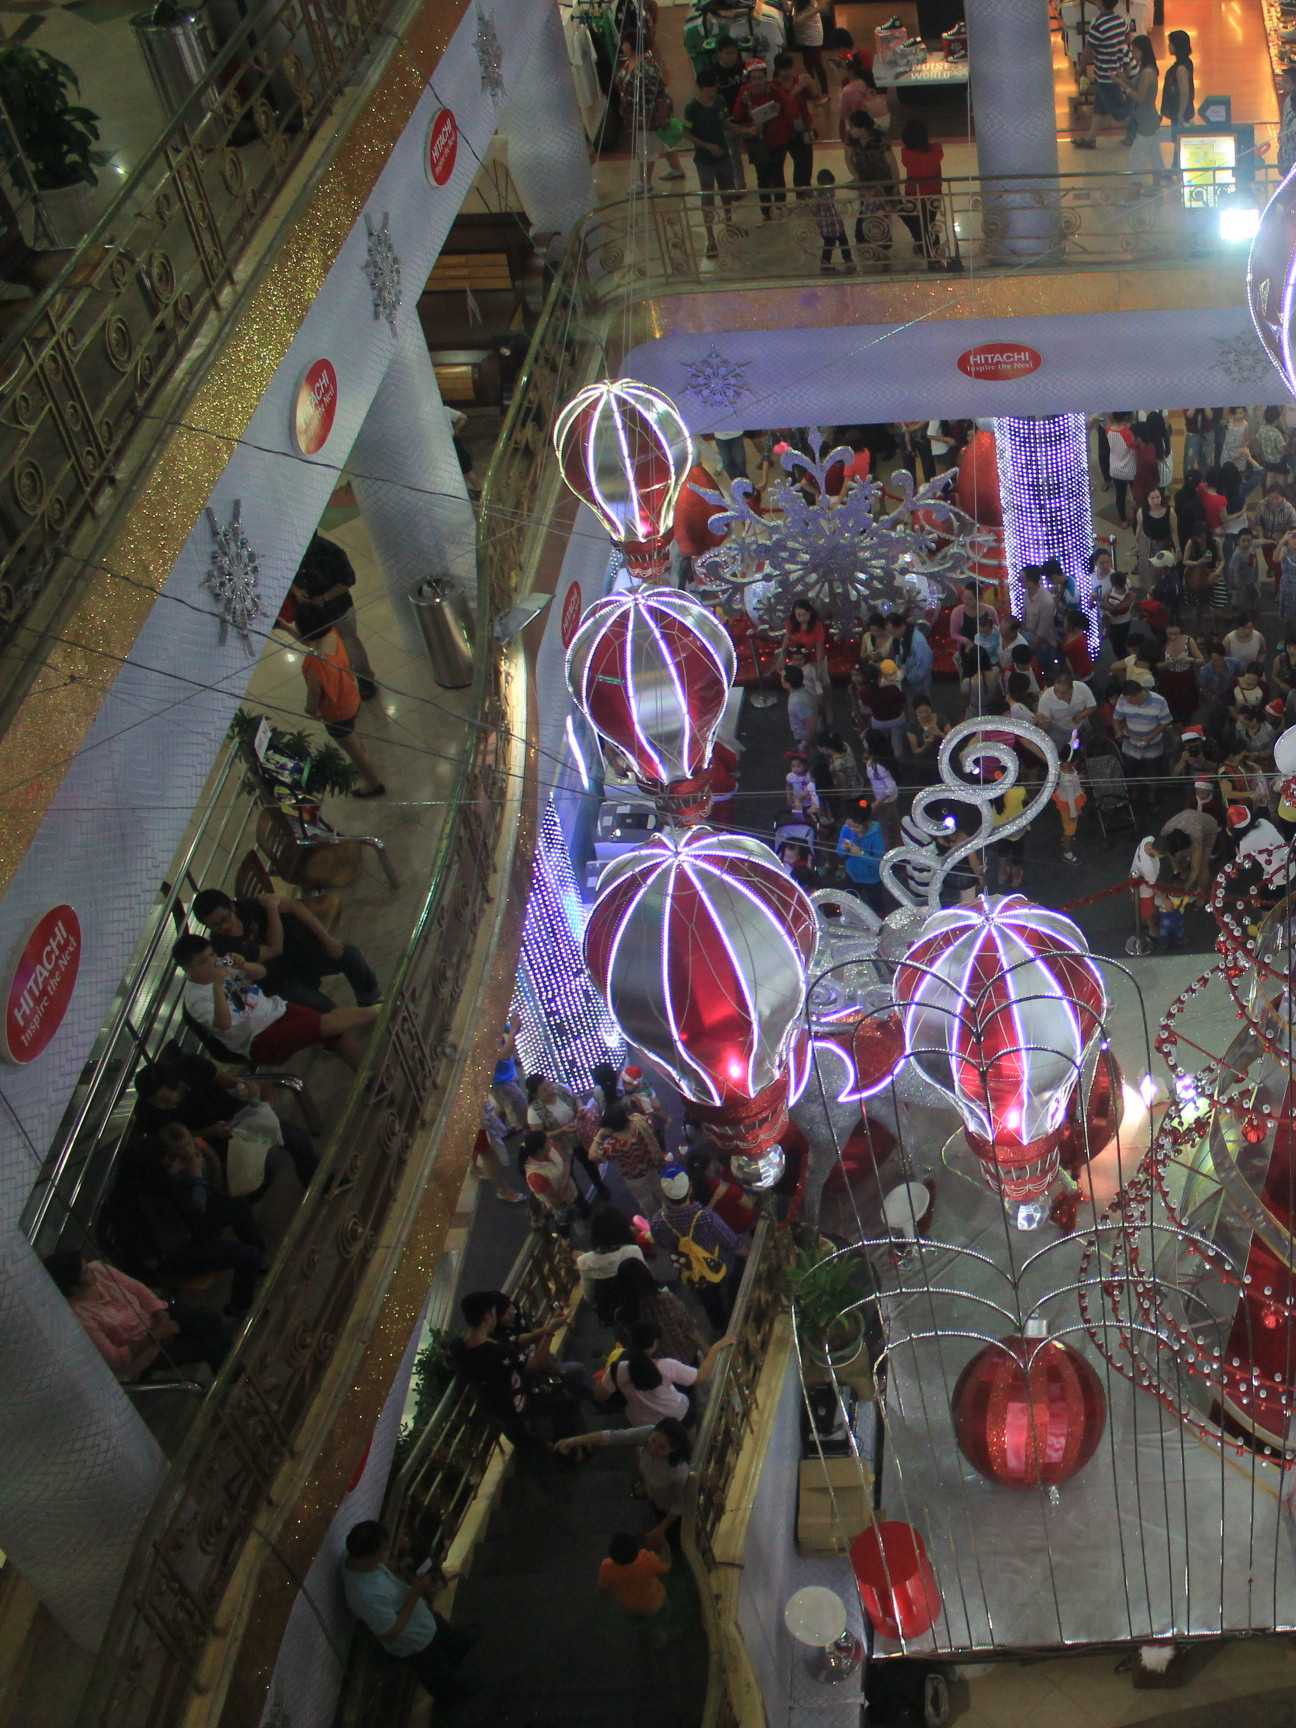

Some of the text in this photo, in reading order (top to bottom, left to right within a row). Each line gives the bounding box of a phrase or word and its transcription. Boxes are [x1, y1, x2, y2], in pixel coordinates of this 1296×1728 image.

[969, 351, 1030, 366] HITACHI
[14, 919, 67, 1028] HITACHI
[19, 934, 78, 1048] Inspire the Next
